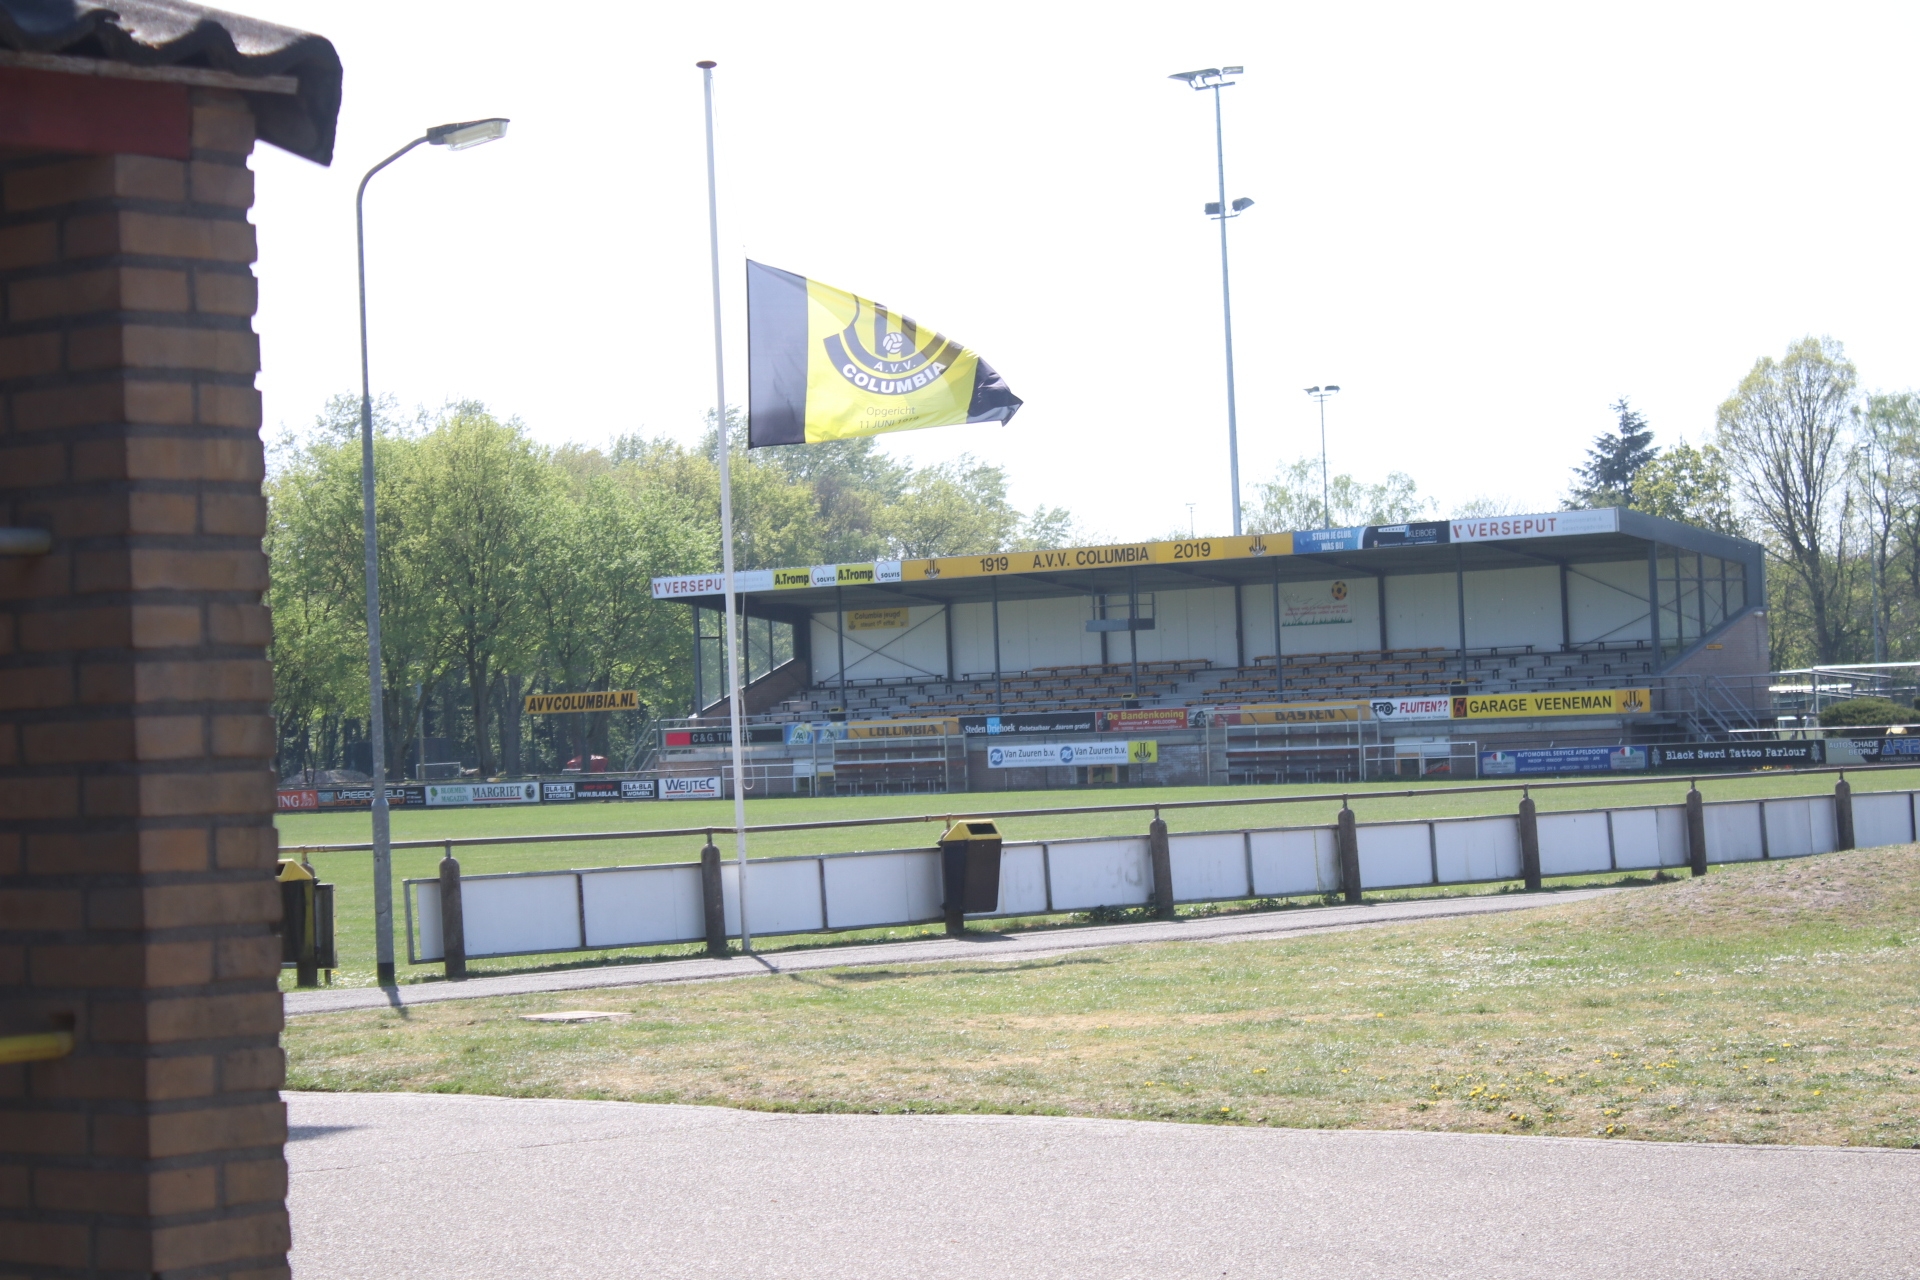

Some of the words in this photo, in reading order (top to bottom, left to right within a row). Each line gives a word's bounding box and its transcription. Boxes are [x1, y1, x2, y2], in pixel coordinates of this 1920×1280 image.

[842, 361, 946, 394] COLUMBIA
[866, 406, 916, 418] Opgericht
[859, 420, 871, 429] 11
[871, 419, 896, 429] JUNI
[1409, 528, 1437, 538] KLEIBOER
[1467, 517, 1557, 538] VERSEPUT
[979, 556, 1009, 573] 1919
[1032, 552, 1071, 569] A.V.V.
[1075, 546, 1149, 567] COLUMBIA
[1173, 541, 1211, 559] 2019
[774, 573, 809, 586] A.Tromp
[837, 568, 873, 581] A.Tromp
[880, 571, 900, 579] SOLVIS
[663, 577, 726, 595] VERSEPU
[527, 692, 636, 712] AVVCOLUMBIA.NL
[1399, 700, 1448, 714] FLUITEN??
[1469, 698, 1528, 713] GARAGE
[1534, 695, 1612, 711] VEENEMAN
[1107, 712, 1118, 721] De
[1121, 709, 1185, 720] Bandenkoning
[717, 731, 753, 742] TIMER
[1074, 747, 1087, 756] Van
[1089, 746, 1113, 755] Zuuren
[1114, 745, 1127, 754] b.v.
[1828, 740, 1879, 750] AUTOSCHADE
[1004, 749, 1016, 758] Van
[1018, 749, 1042, 758] Zuuren
[1043, 748, 1056, 757] b.v.
[1552, 749, 1575, 757] SERVICE
[1575, 748, 1609, 756] APELDOORN
[1666, 750, 1695, 761] Black
[1697, 749, 1726, 759] Sword
[1730, 748, 1762, 759] Tattoo
[1765, 747, 1807, 758] Parlour
[1848, 748, 1879, 756] BEDRIJF
[440, 786, 467, 795] BLOEMEN
[472, 785, 522, 798] MARGRIET
[545, 785, 573, 793] BLA-BLA
[623, 783, 652, 791] BLA-BLA
[336, 789, 405, 800] VREEDEELD
[277, 794, 300, 808] ING
